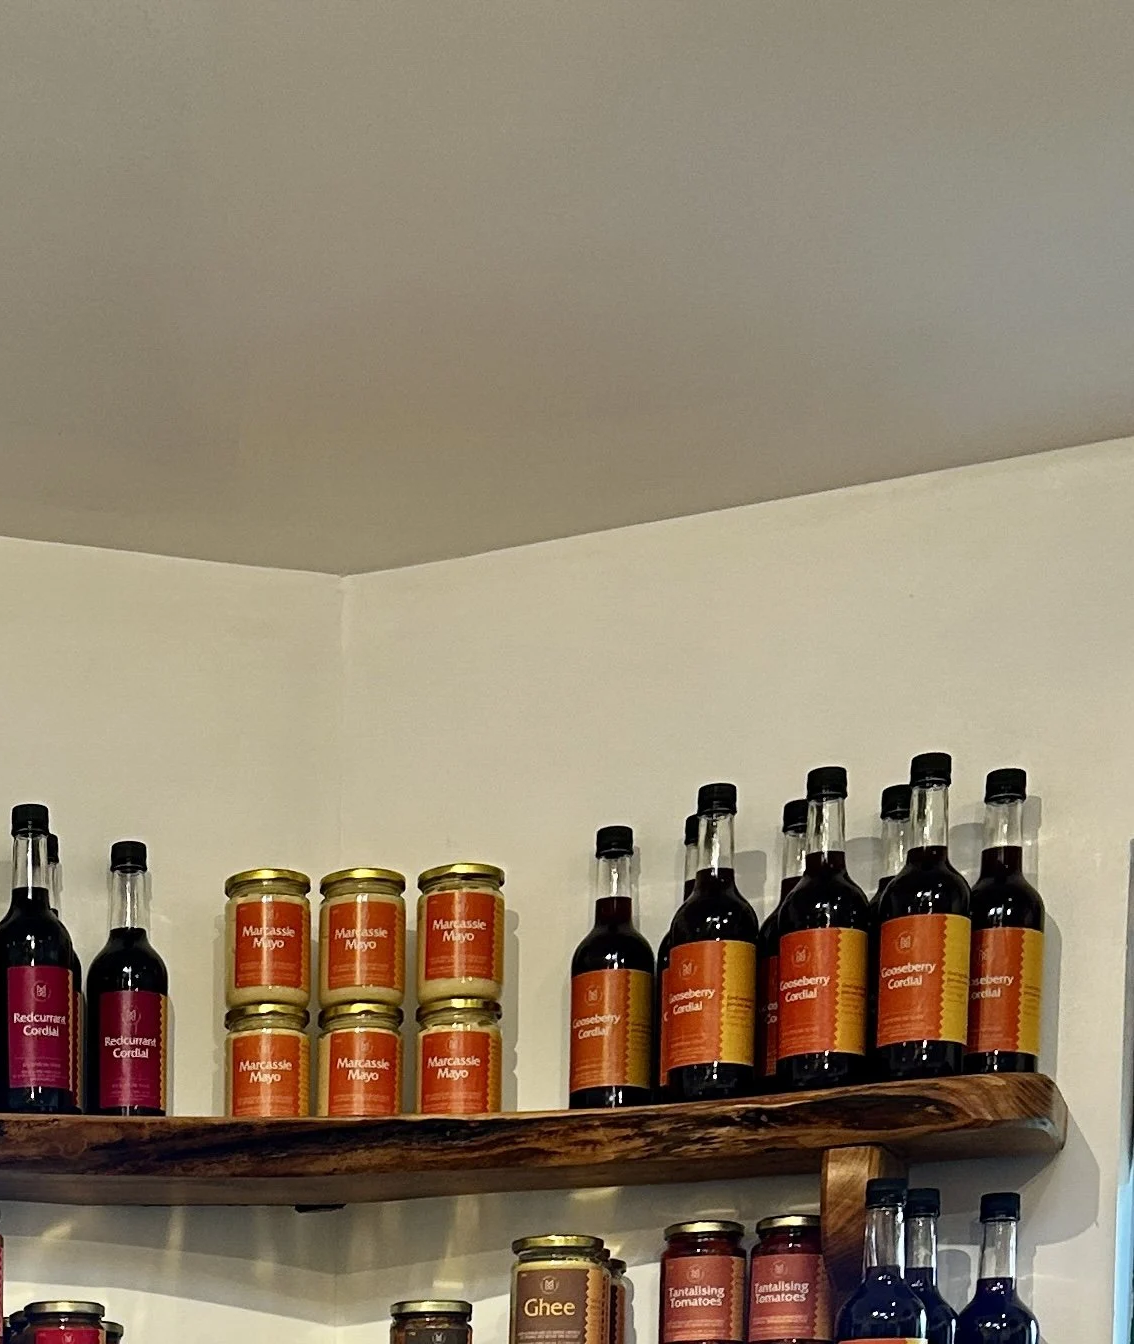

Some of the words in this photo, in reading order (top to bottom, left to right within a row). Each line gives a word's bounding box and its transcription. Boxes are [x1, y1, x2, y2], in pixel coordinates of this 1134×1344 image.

[432, 919, 486, 930] Marcassie
[242, 925, 295, 938] Marcassie
[334, 927, 388, 938] Marcassie
[442, 930, 475, 943] Mayo
[253, 937, 285, 949] Mayo
[345, 938, 377, 951] Mayo
[881, 961, 936, 978] Gooseberry
[780, 974, 830, 992] Gooseberry
[887, 975, 923, 990] Cordial
[669, 987, 715, 1003] Gooseberry
[785, 988, 818, 1003] Cordial
[971, 988, 1001, 1000] ordial
[673, 1001, 703, 1015] Cordial
[13, 1012, 66, 1025] Redcurrant
[573, 1013, 621, 1030] Gooseberry
[23, 1024, 59, 1037] Cordial
[578, 1026, 611, 1040] Cordial
[105, 1036, 156, 1048] Redcurrant
[113, 1048, 149, 1059] Cordial
[239, 1060, 293, 1072] Marcassie
[337, 1058, 390, 1070] Marcassie
[427, 1056, 481, 1067] Marcassie
[249, 1071, 281, 1083] Mayo
[347, 1069, 379, 1082] Mayo
[436, 1067, 469, 1080] Mayo
[668, 1285, 725, 1299] Tantalising
[754, 1280, 809, 1295] Tantalising
[669, 1296, 723, 1308] Tomatoes
[755, 1292, 806, 1304] Tomatoes
[524, 1298, 576, 1317] Ghee
